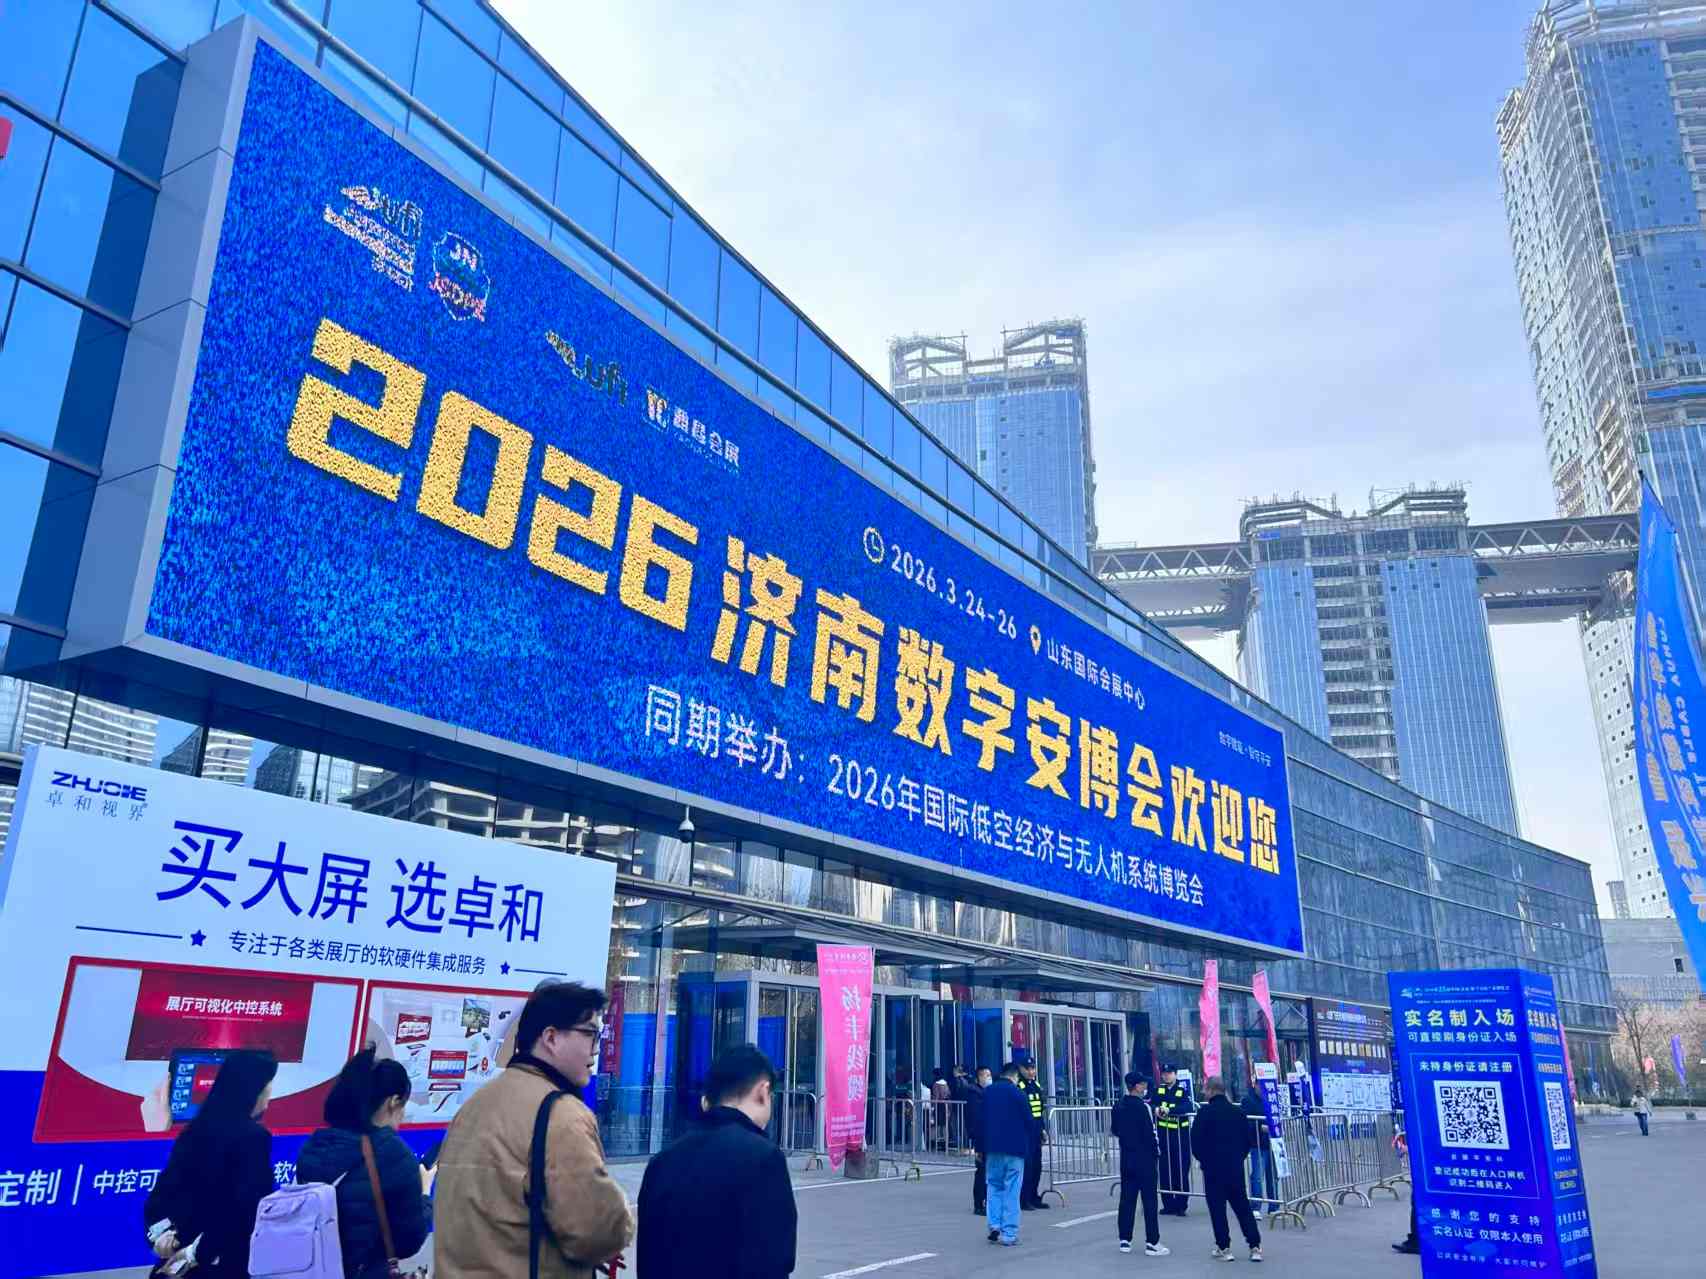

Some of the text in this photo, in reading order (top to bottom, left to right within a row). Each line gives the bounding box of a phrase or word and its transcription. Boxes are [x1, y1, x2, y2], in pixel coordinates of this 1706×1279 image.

[891, 544, 1146, 711] 2026.3.24-26 山东国际会展中心
[156, 820, 544, 943] 买大屏 选卓和
[229, 930, 486, 976] 专注于各类展厅的软硬件集成服务
[165, 995, 283, 1017] 展厅可视化中控系统
[1404, 1007, 1516, 1028] 实名制入场
[1408, 1030, 1518, 1044] 可直接刷身份证入场
[1420, 1060, 1513, 1073] 未持身份证请注册
[0, 1168, 61, 1207] 定制
[274, 1160, 297, 1184] 软
[1431, 1207, 1541, 1227] 感谢您的支持
[1432, 1225, 1474, 1239] 实名认证
[1479, 1229, 1544, 1245] 仅限本人使用
